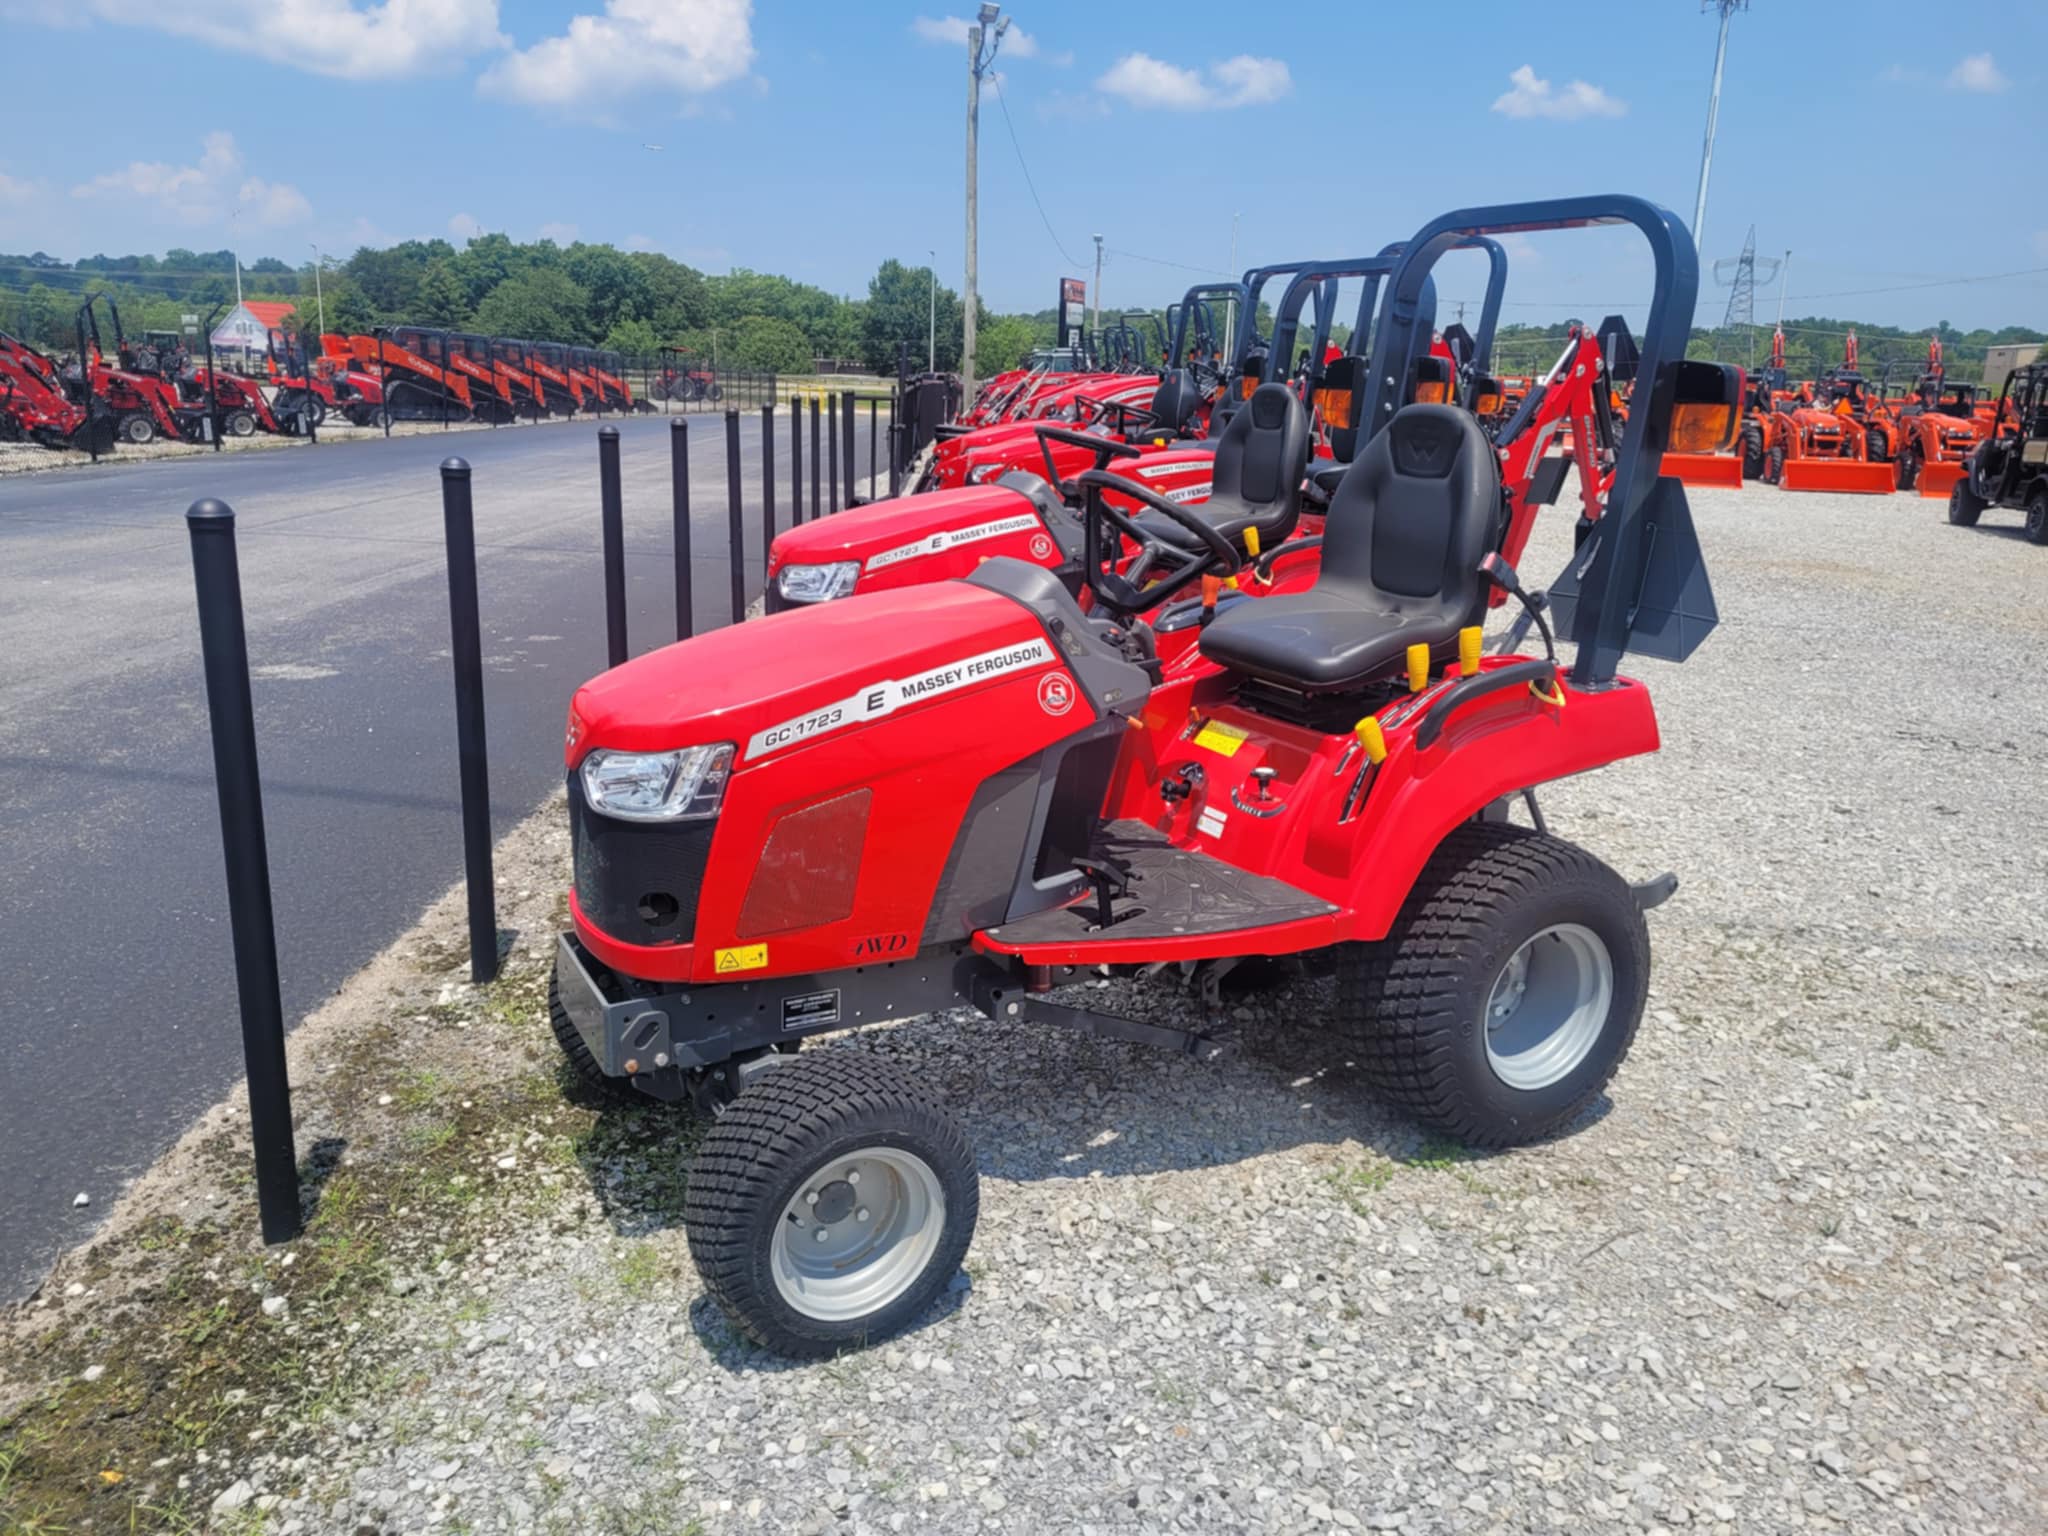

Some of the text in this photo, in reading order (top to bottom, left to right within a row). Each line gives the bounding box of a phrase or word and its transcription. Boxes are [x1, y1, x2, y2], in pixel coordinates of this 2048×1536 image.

[931, 536, 943, 549] E
[951, 528, 986, 543] MASSEY
[988, 517, 1033, 533] FERGUSON
[764, 646, 1042, 747] GC 1723 E MASSEY FERGUSON
